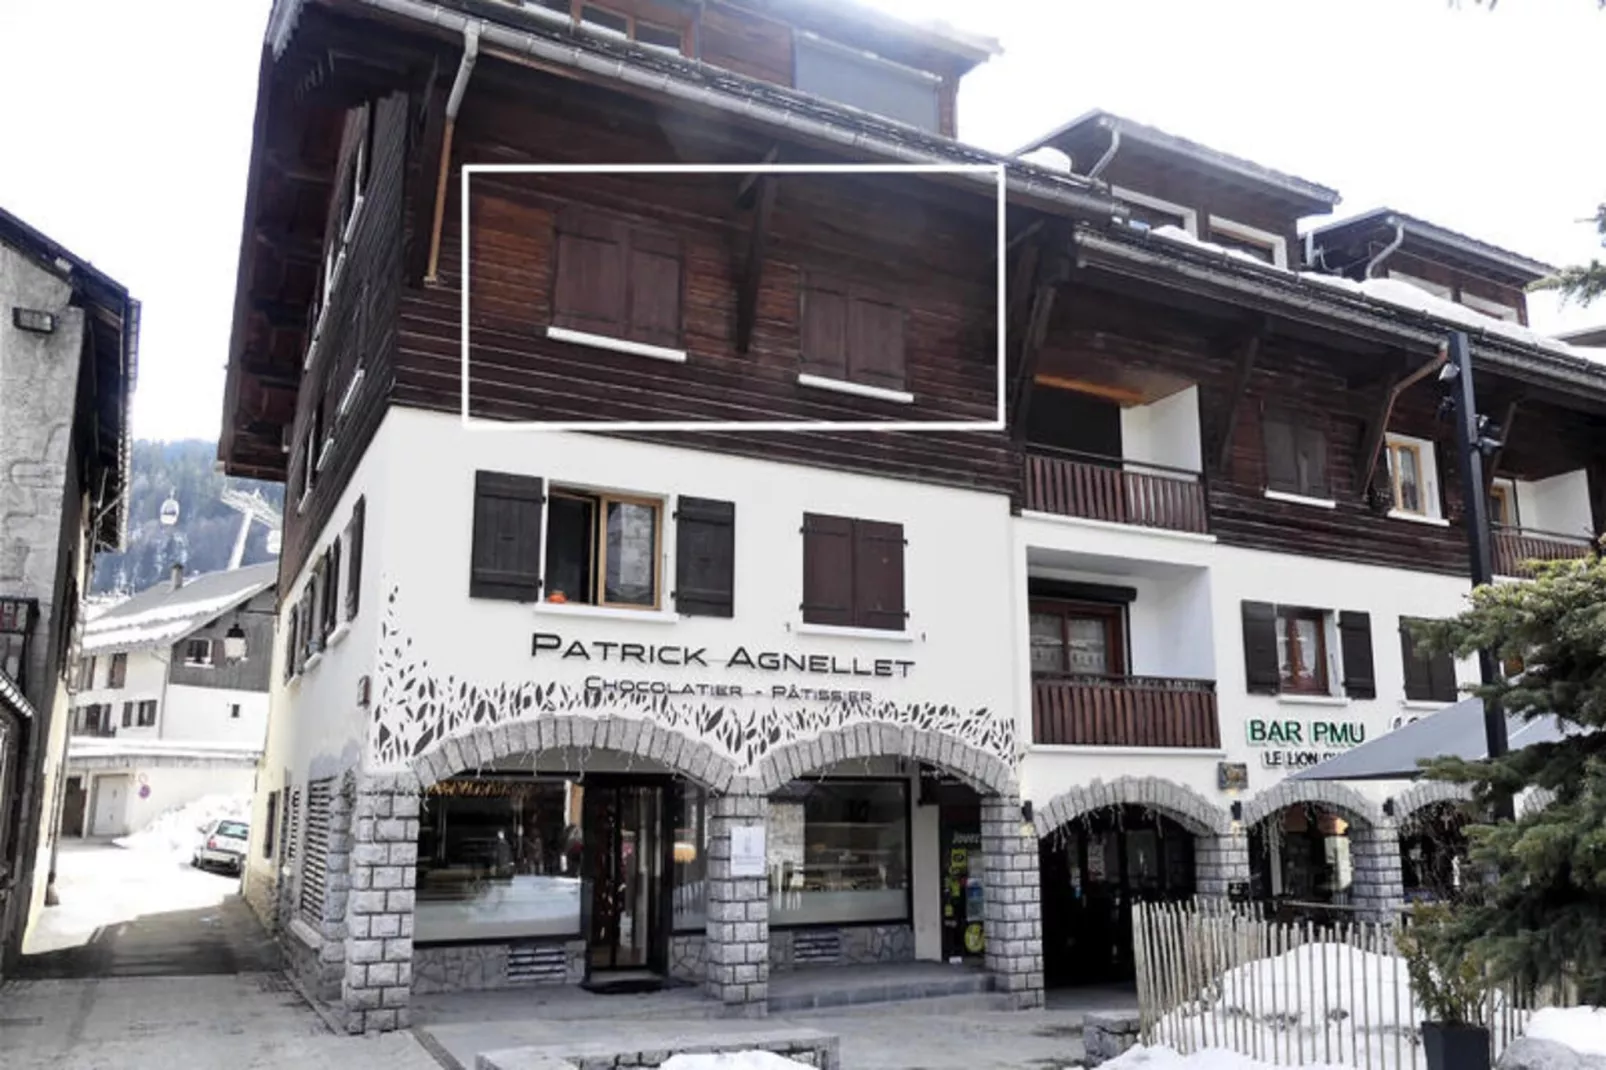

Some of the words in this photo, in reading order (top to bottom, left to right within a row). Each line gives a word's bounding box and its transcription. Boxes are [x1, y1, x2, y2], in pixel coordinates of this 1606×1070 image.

[531, 632, 708, 667] PATRICK
[725, 646, 916, 678] AGNELLET
[584, 675, 743, 698] CHOCOLATIER
[1249, 719, 1303, 742] BAR
[1312, 721, 1365, 744] PMU
[1265, 751, 1282, 766] LE
[1287, 751, 1318, 766] LION
